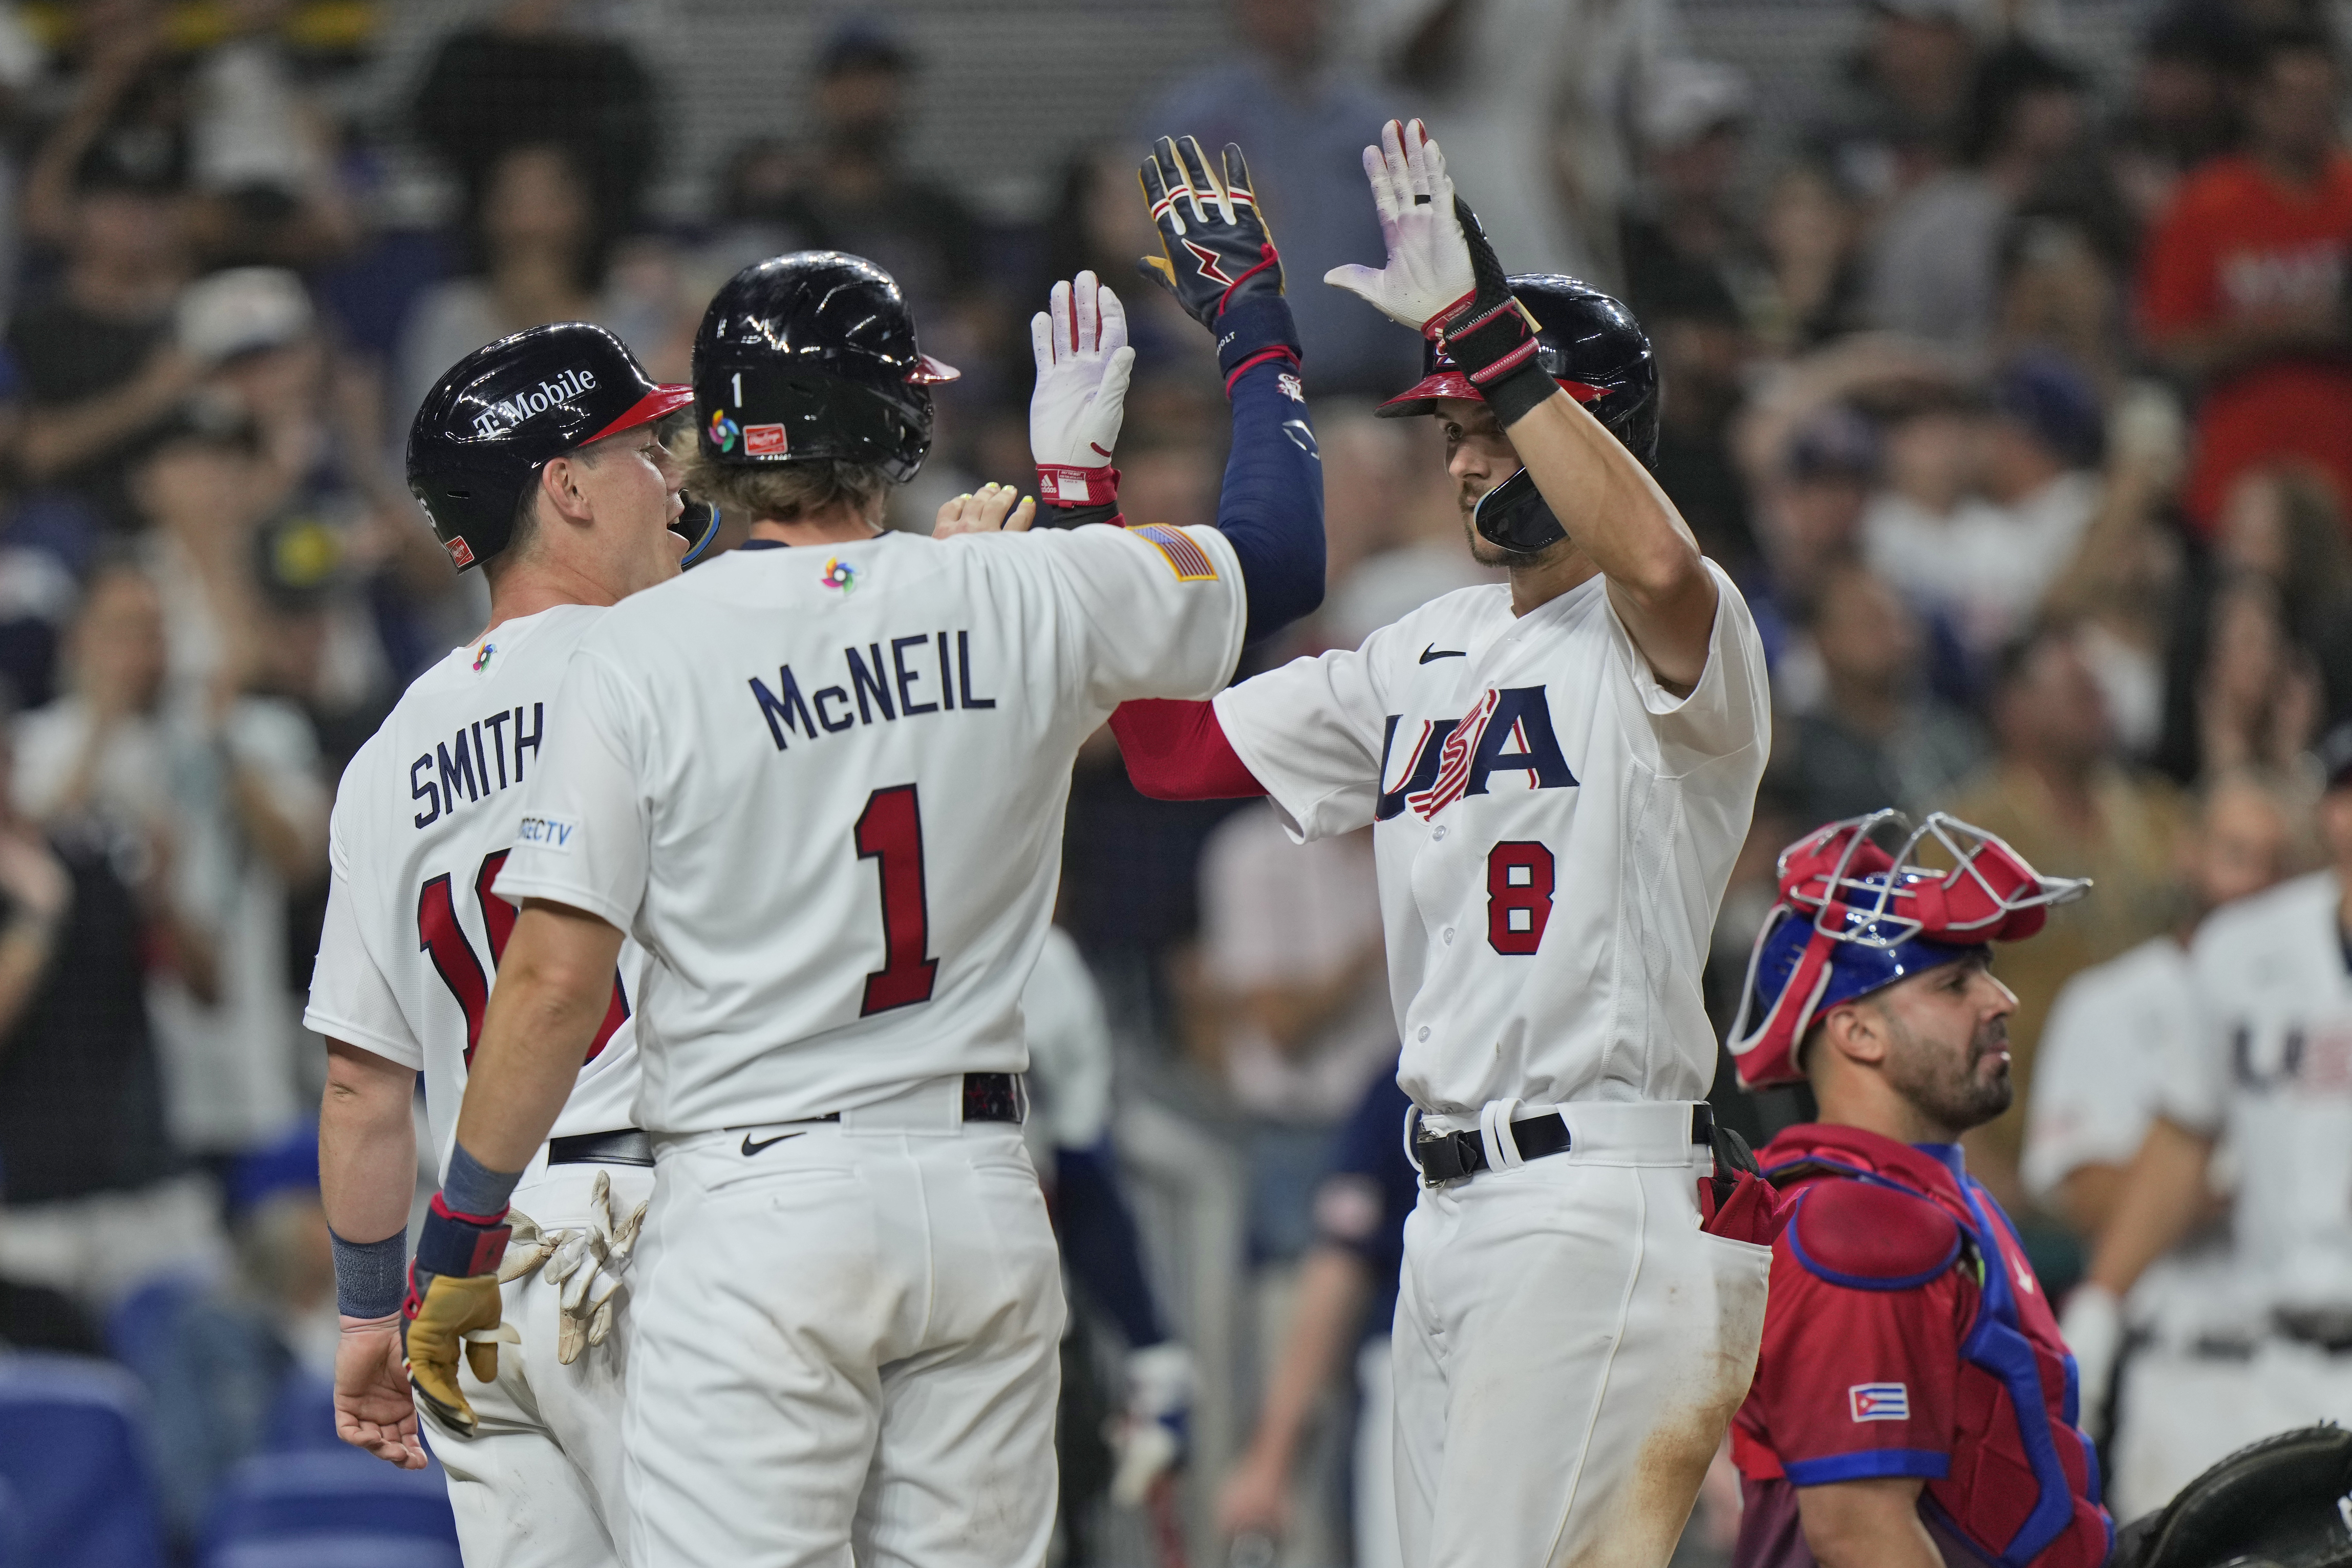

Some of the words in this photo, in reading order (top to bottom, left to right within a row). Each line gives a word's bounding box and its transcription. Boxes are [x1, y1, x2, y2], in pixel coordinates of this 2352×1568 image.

[732, 372, 742, 408] 1
[410, 702, 543, 829] SMITH
[1374, 684, 1580, 823] USA
[854, 783, 940, 1018] 1
[1487, 841, 1555, 955] 8
